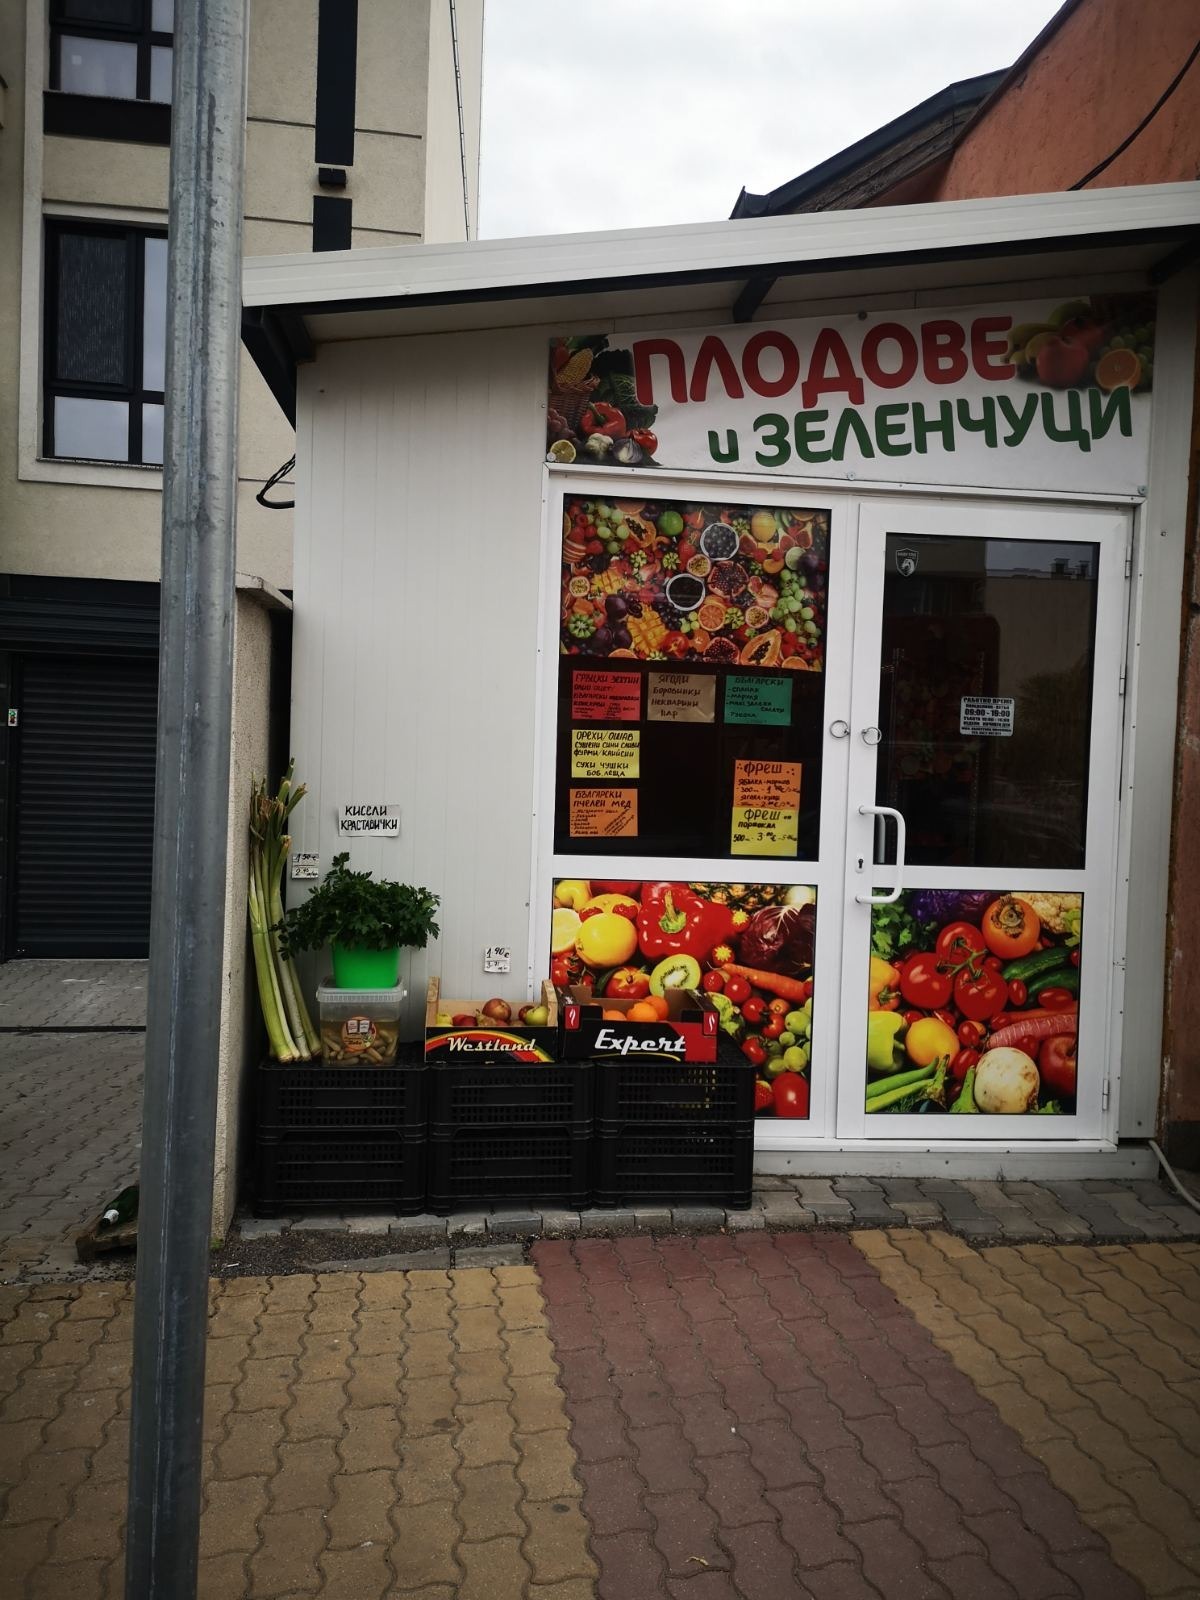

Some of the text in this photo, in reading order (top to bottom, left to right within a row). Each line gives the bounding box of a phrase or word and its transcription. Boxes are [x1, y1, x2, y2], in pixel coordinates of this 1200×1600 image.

[632, 316, 1016, 408] ПЛОДОВЕ
[753, 386, 1133, 467] ЗЕЛЕНЧУЦИ
[658, 675, 689, 685] ЯГОДИ
[575, 761, 596, 769] СУХИ
[575, 790, 622, 799] БЪЛГАРСКИ
[345, 805, 387, 816] КИСЕЛИ
[340, 819, 398, 831] КРАСТАВИЧКИ
[447, 1037, 536, 1052] Westland
[594, 1029, 686, 1055] Expert
